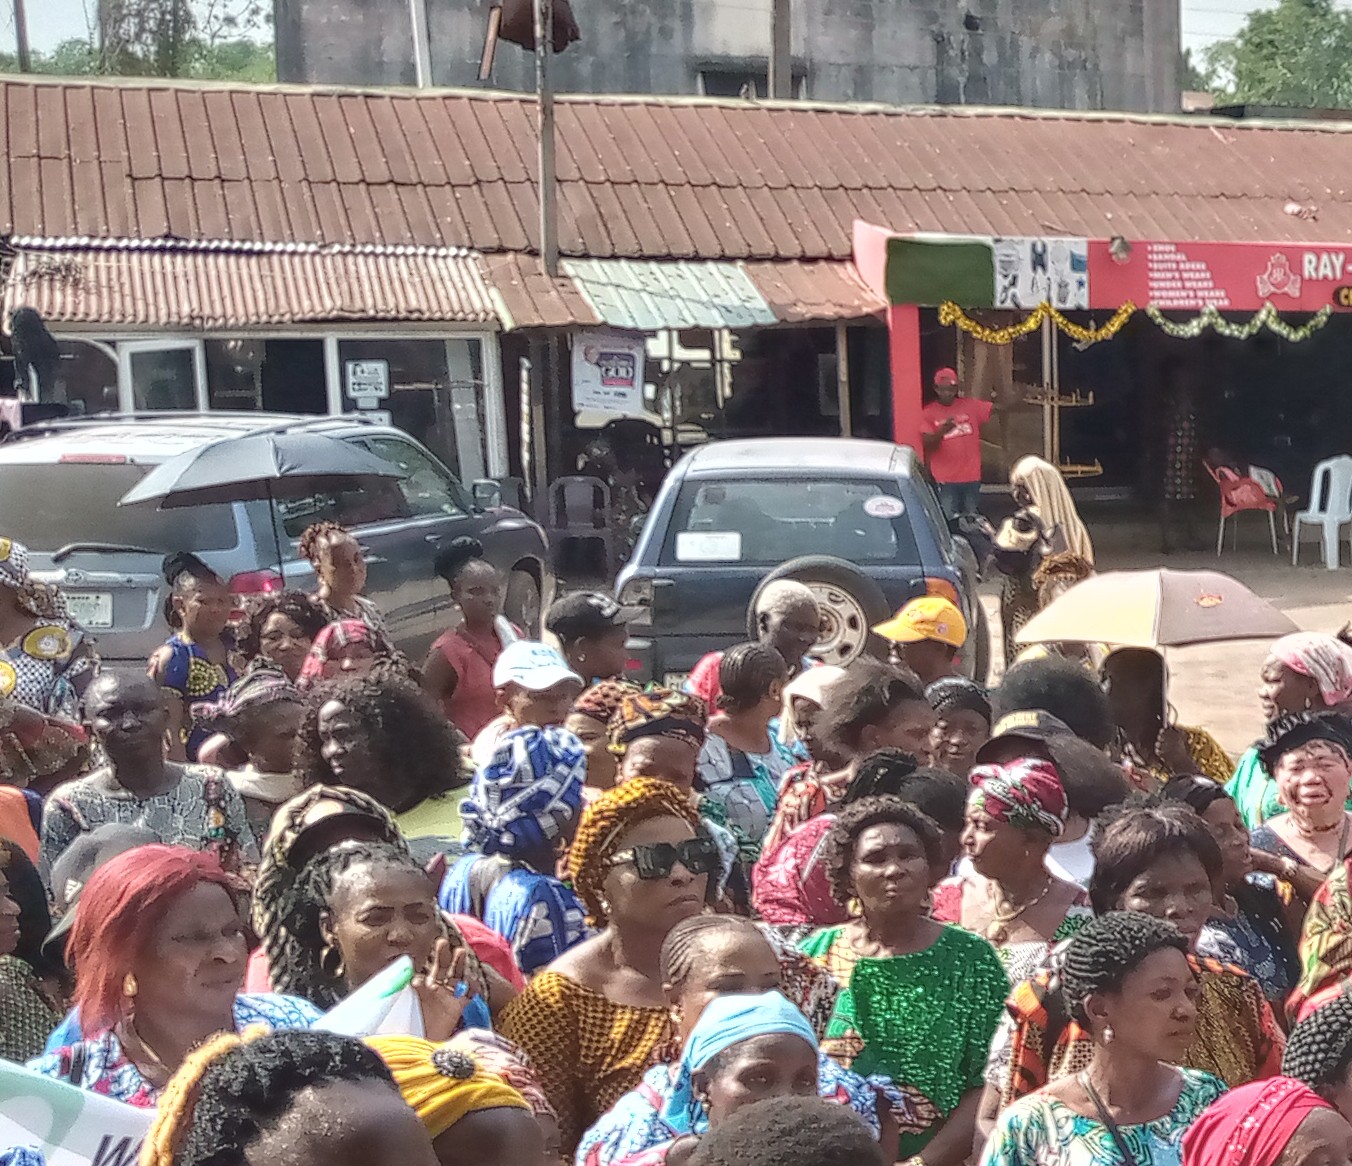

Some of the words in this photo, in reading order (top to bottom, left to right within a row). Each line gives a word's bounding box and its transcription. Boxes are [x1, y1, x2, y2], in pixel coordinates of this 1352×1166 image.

[1153, 271, 1180, 279] MEN'S
[1182, 271, 1211, 279] WEARS
[1153, 280, 1182, 288] UNDER
[1184, 280, 1214, 288] WEARS
[1153, 289, 1194, 297] WOMEN'S
[1196, 289, 1225, 298] WEARS
